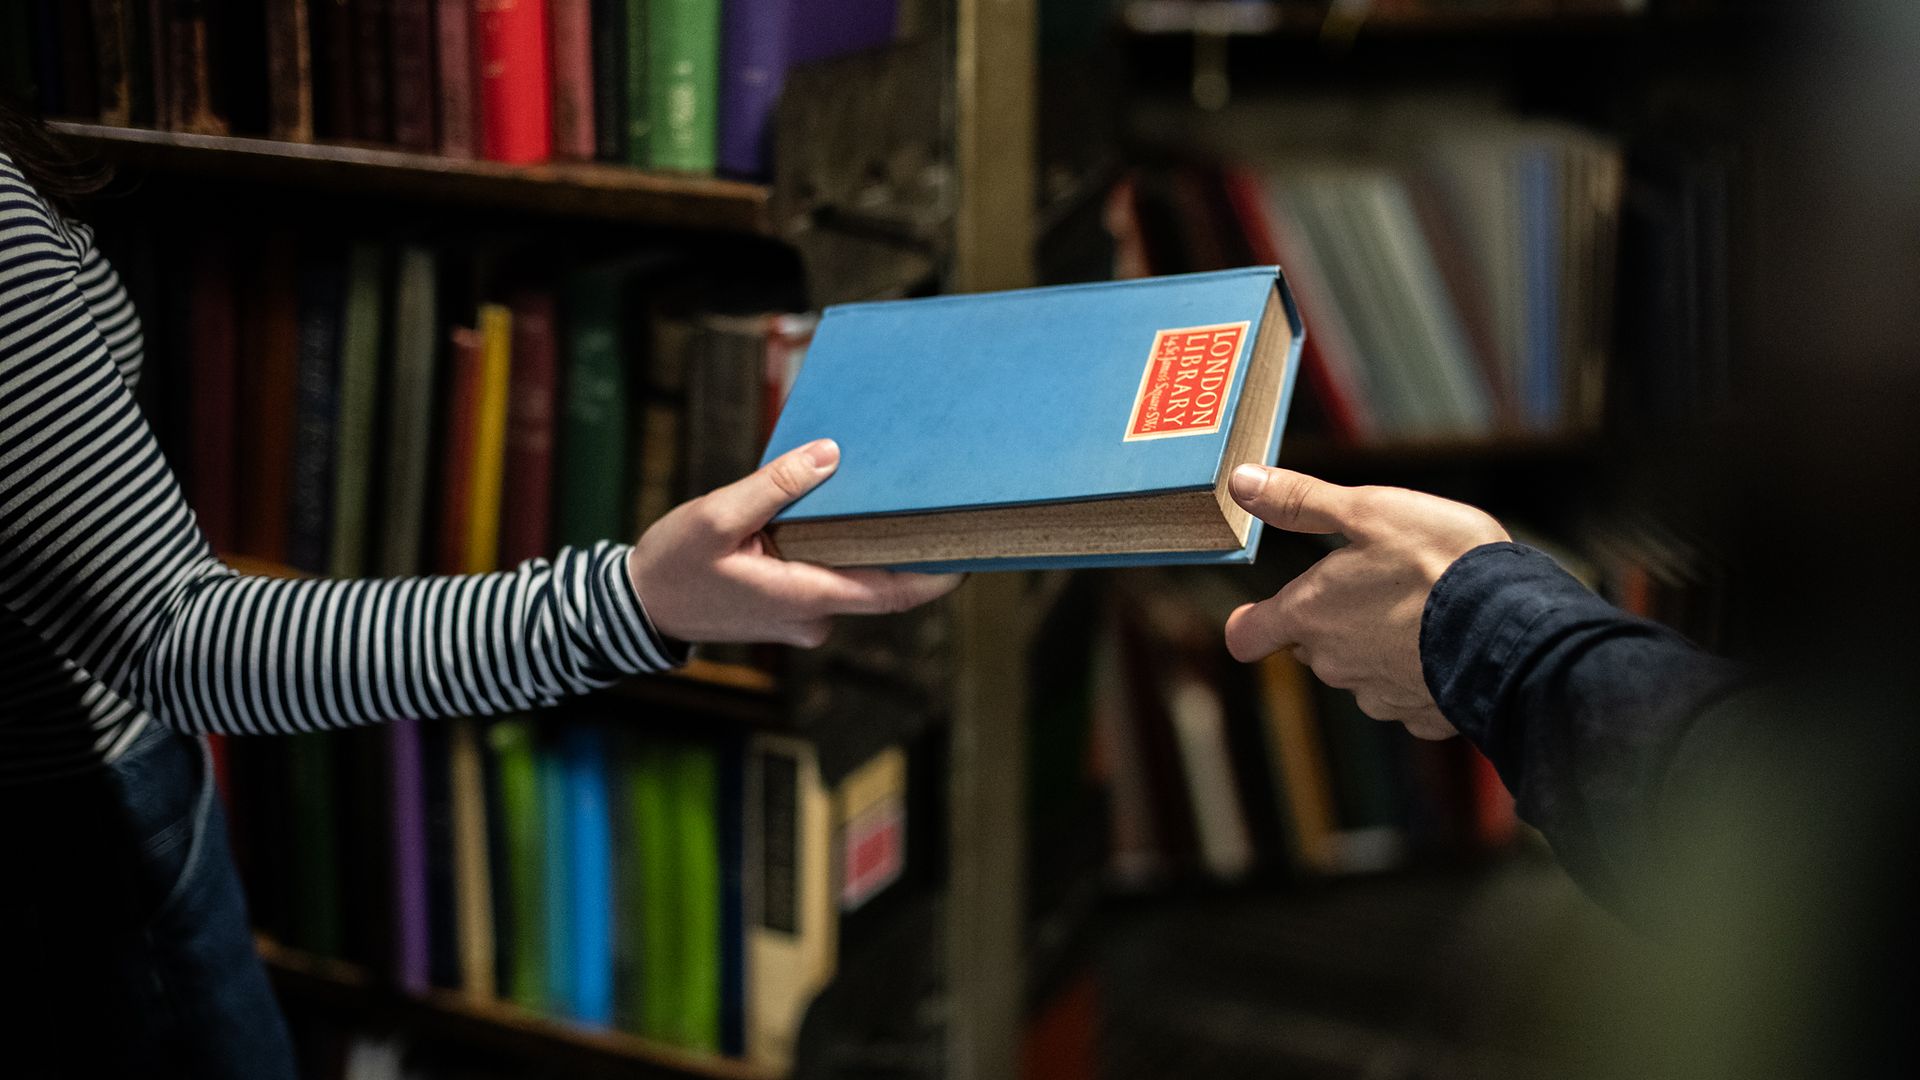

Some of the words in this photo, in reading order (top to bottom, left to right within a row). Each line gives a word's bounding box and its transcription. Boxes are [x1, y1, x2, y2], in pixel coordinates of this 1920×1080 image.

[1143, 381, 1169, 411] Square
[1163, 334, 1210, 426] LIBRARY
[1190, 331, 1237, 425] LONDON
